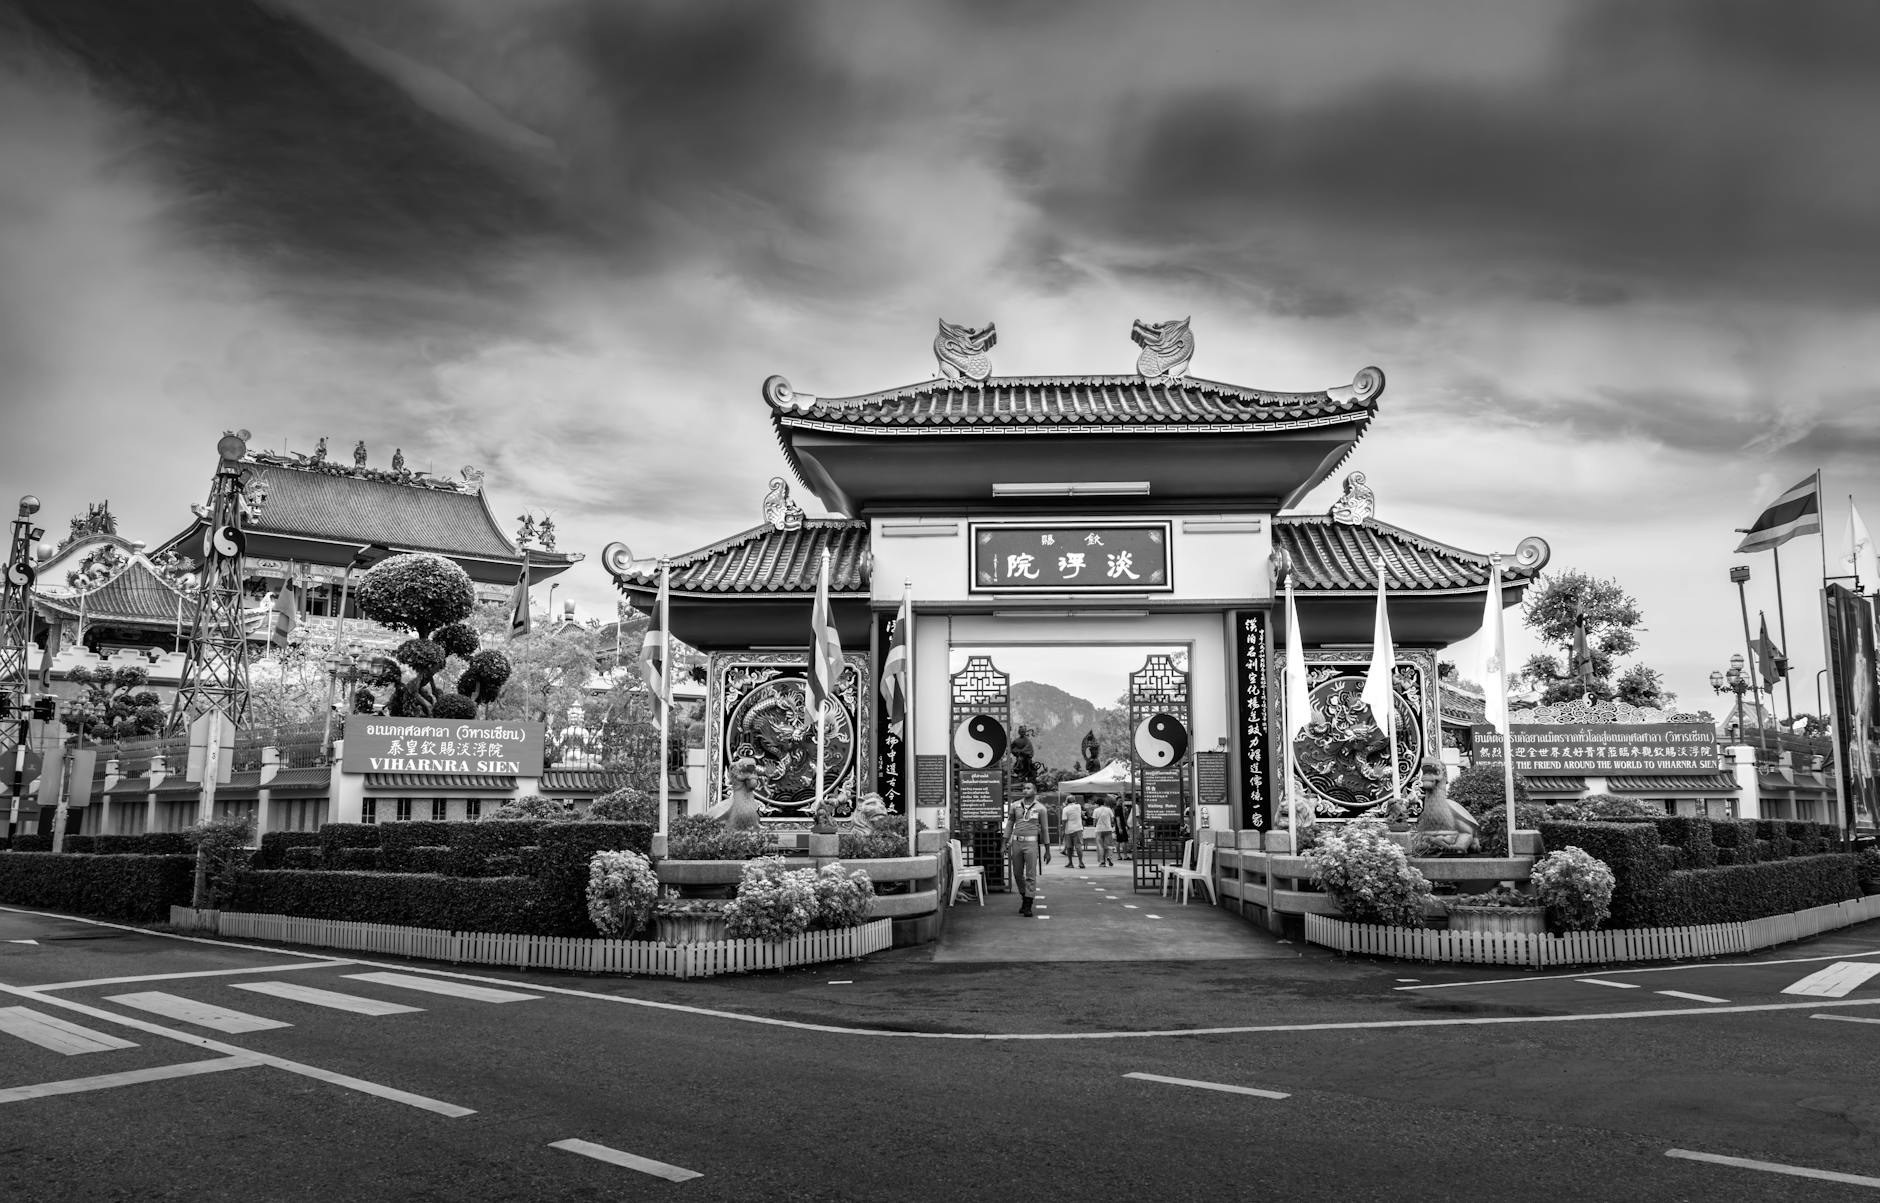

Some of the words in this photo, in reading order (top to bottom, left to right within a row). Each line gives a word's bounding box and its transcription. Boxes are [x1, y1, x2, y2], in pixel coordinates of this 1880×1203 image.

[368, 757, 470, 772] VIHARNRA
[476, 760, 521, 773] SIEN
[1516, 760, 1532, 769] THE
[1533, 760, 1562, 769] FRIEND
[1563, 760, 1596, 769] AROUND
[1597, 760, 1612, 769] THE
[1613, 760, 1643, 769] WORLD
[1644, 760, 1655, 769] TO
[1657, 760, 1697, 769] VIHARNRA
[1699, 760, 1718, 769] SIEN
